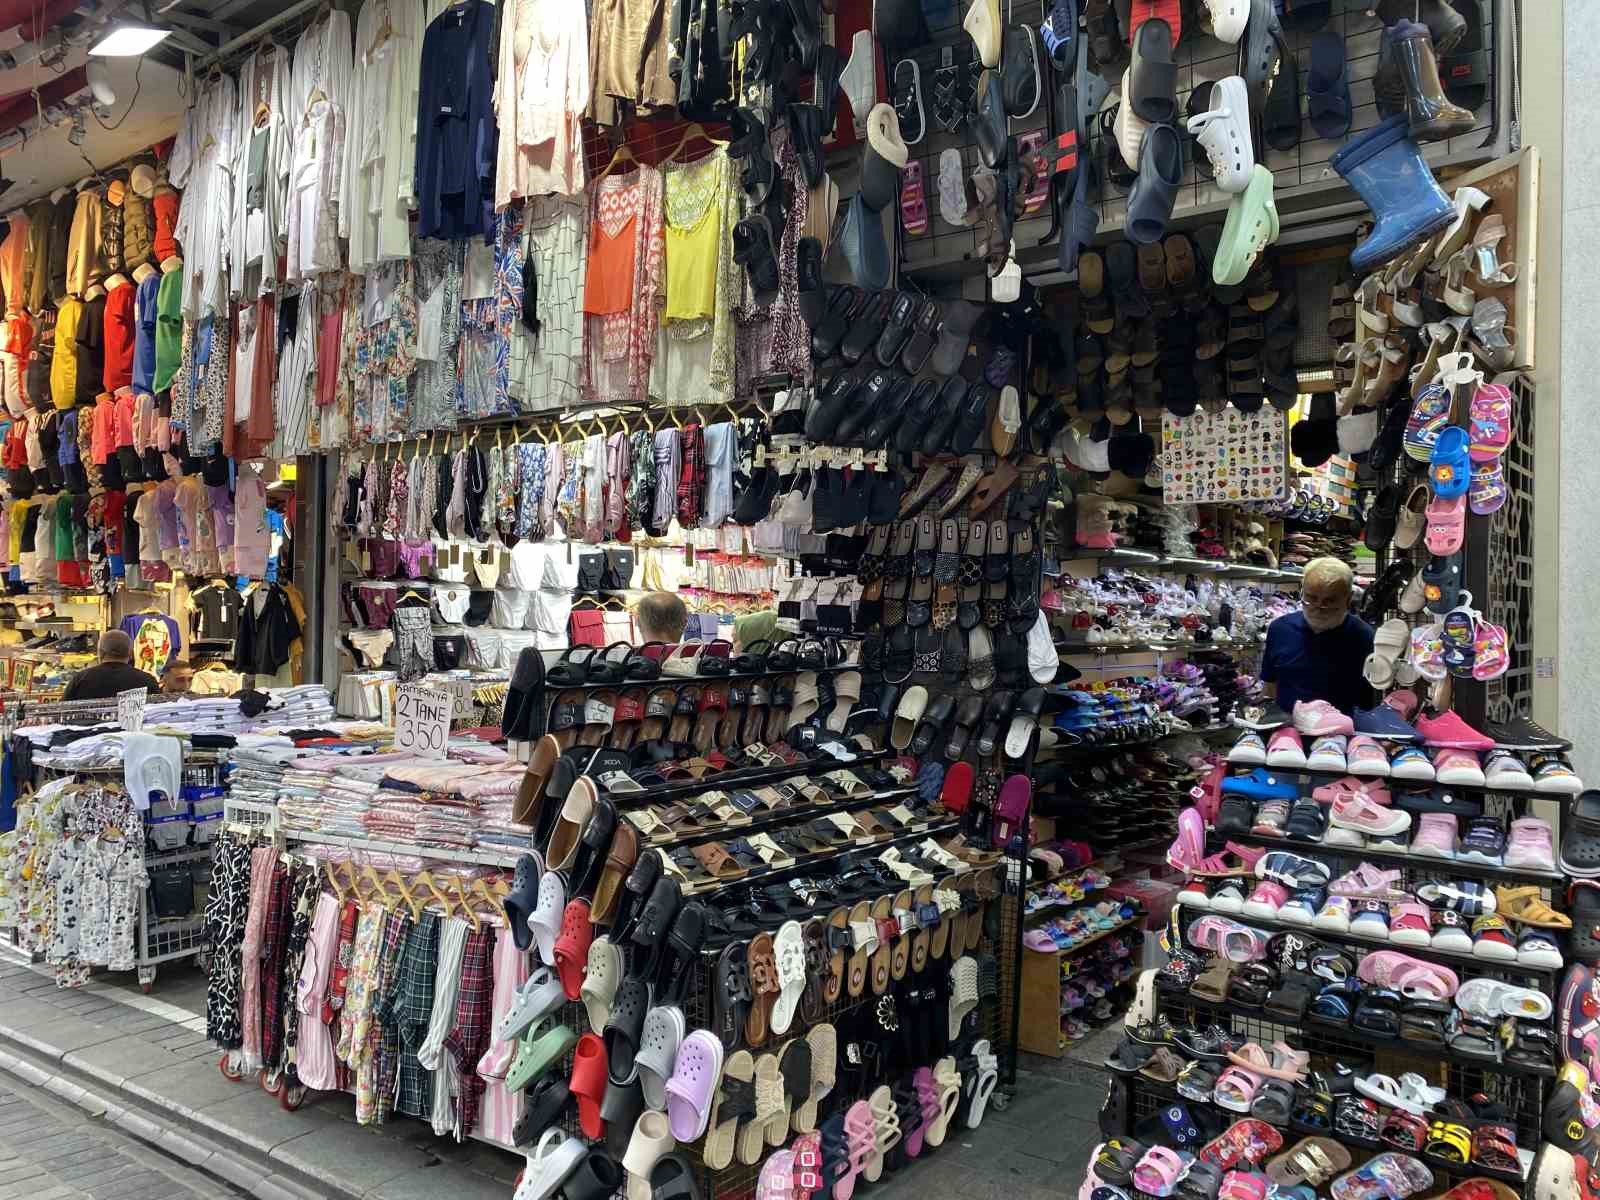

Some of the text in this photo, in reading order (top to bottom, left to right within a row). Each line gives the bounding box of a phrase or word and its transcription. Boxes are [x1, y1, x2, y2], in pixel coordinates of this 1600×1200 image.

[399, 693, 410, 718] 2
[413, 698, 447, 723] TANE
[400, 719, 443, 751] 350
